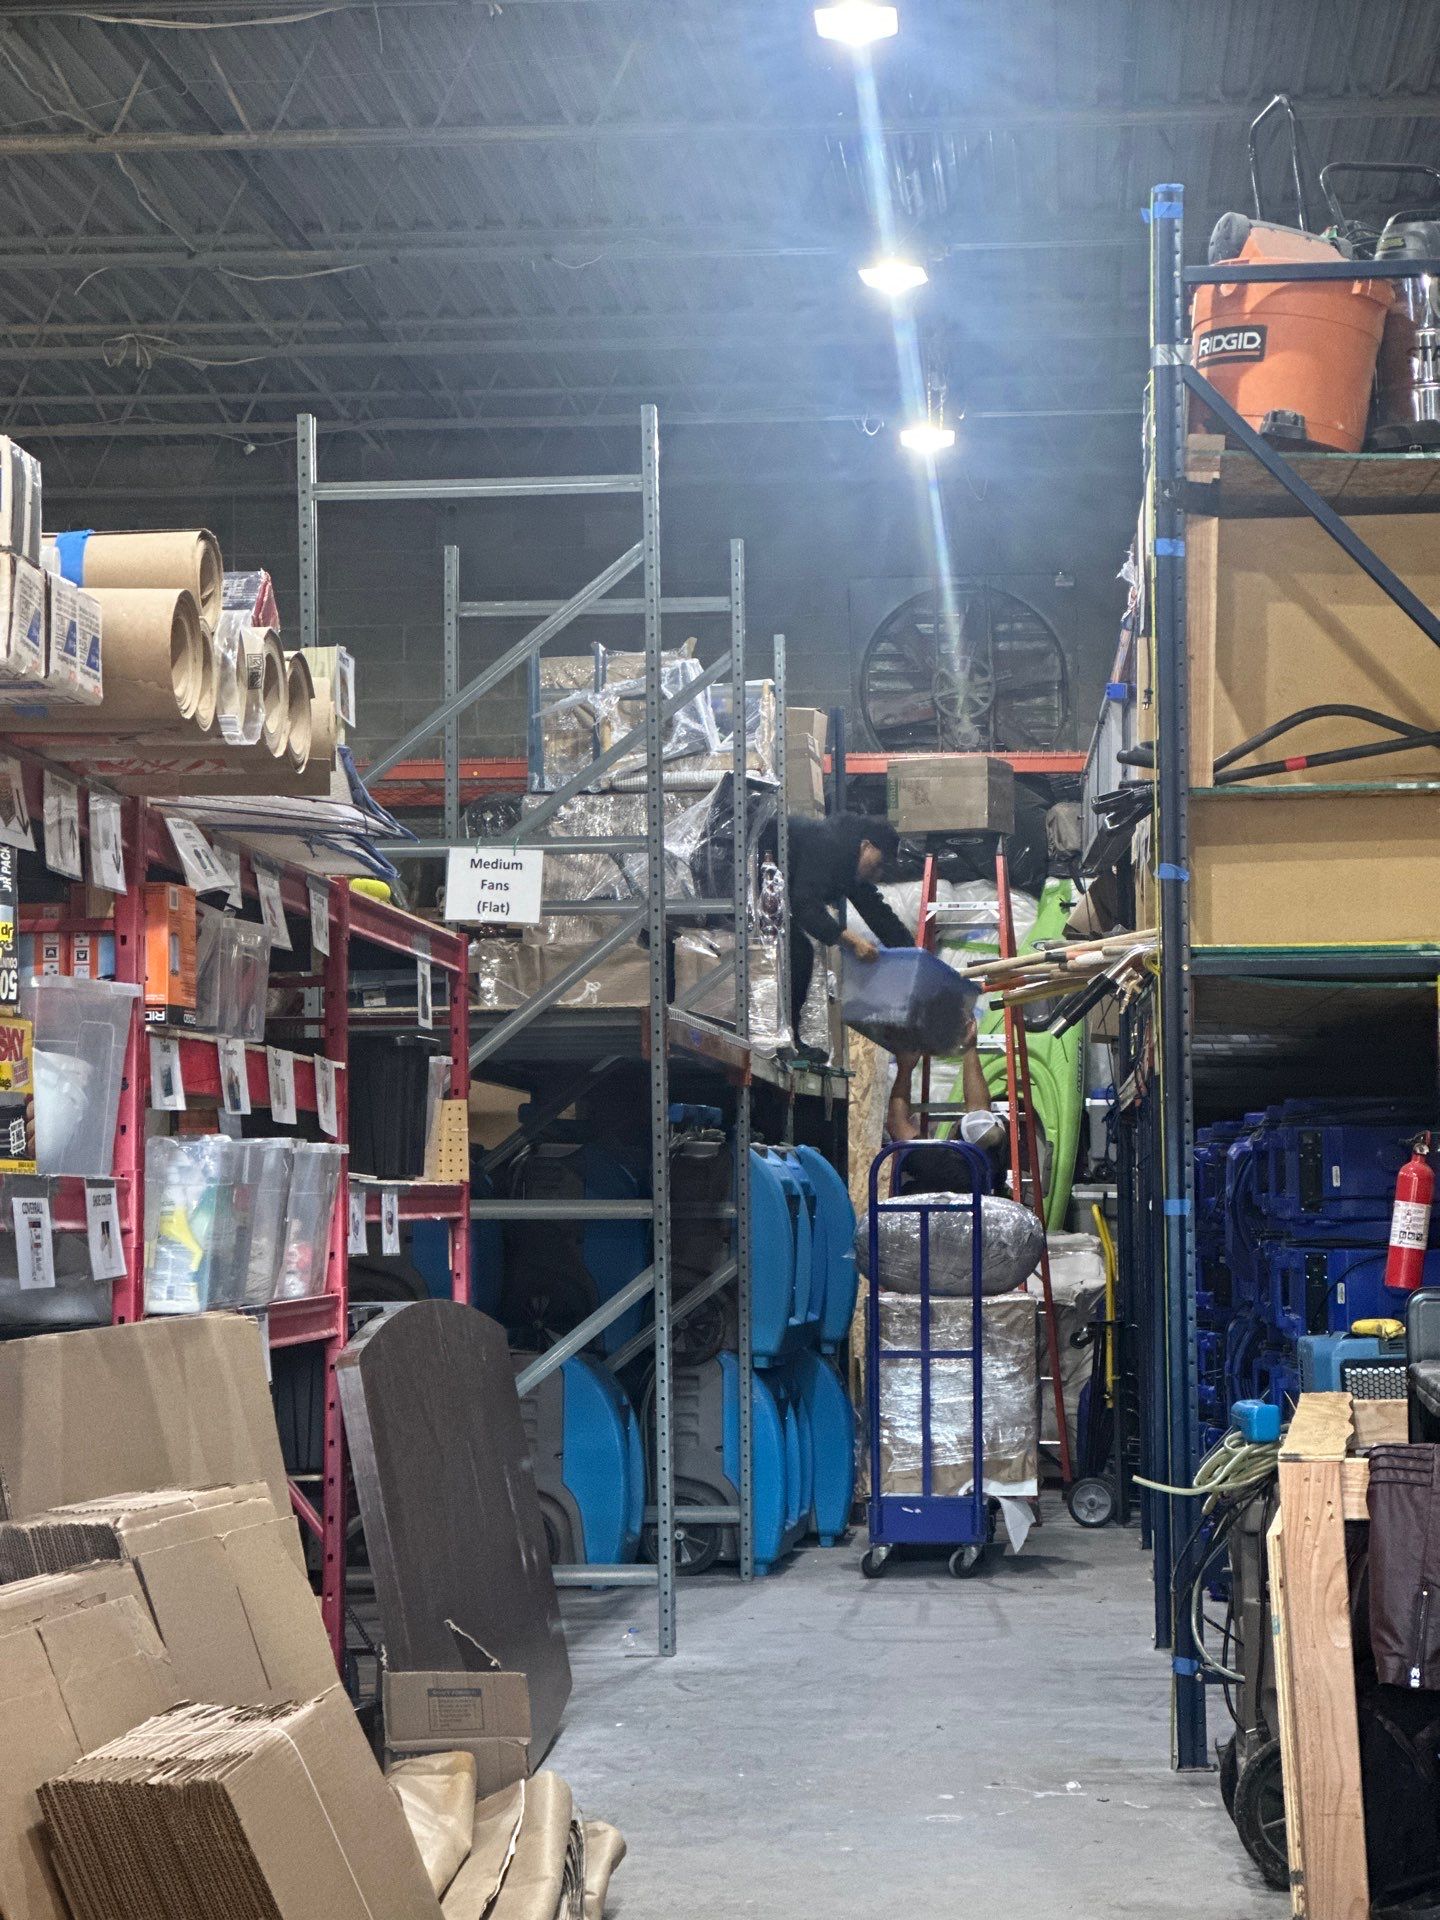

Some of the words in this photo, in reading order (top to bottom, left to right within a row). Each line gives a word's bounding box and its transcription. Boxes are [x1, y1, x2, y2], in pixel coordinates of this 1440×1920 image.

[1199, 332, 1261, 356] RIDGID
[470, 858, 523, 870] Medium
[481, 879, 510, 891] Fans
[477, 900, 510, 915] (Flat)
[0, 969, 18, 1000] 50
